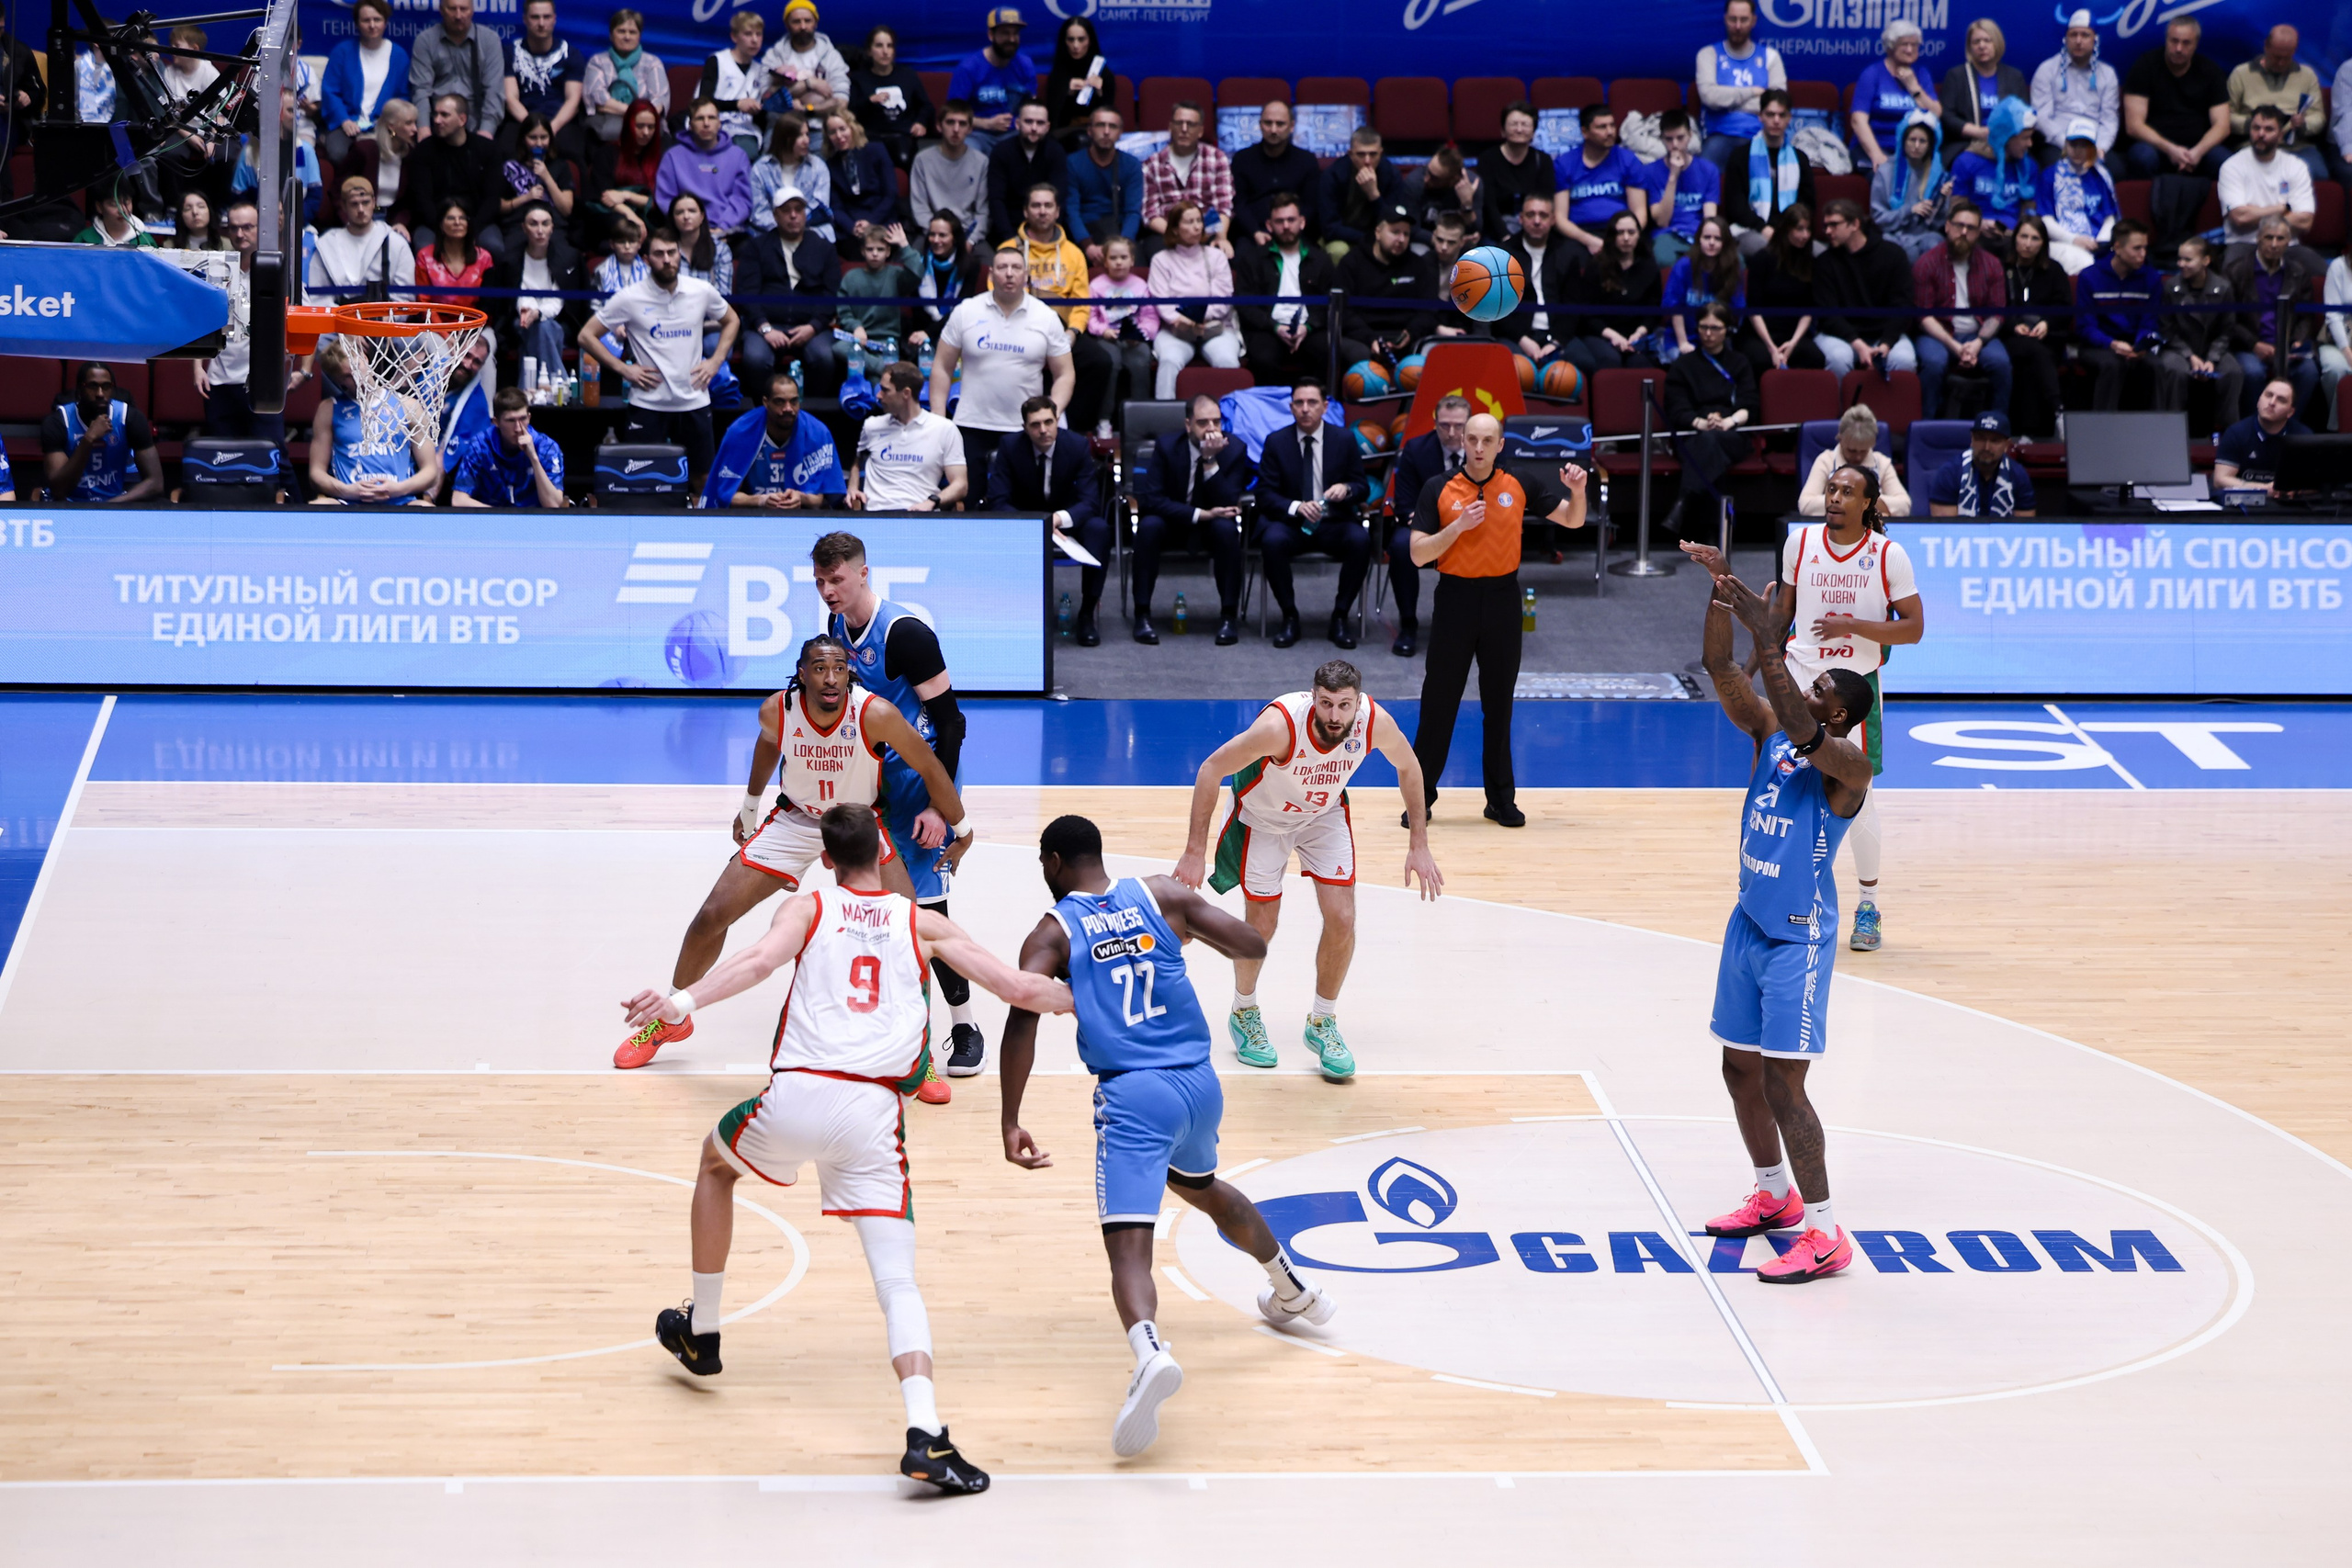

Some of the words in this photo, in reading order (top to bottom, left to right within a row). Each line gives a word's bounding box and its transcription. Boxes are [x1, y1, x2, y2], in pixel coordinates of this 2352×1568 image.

[1919, 530, 2172, 568] ТИТУЛЬНЫЙ
[2184, 537, 2352, 570] СПОНСО
[115, 570, 359, 604] ТИТУЛЬНЫЙ
[369, 577, 559, 607] СПОНСОР
[1811, 573, 1870, 589] LOKOMOTIV
[1821, 591, 1857, 604] KUBAN
[1961, 570, 2134, 615] ЕДИНОЙ
[2144, 579, 2256, 610] ЛИГИ
[2268, 579, 2343, 610] ВТБ
[152, 606, 322, 647] ЕДИНОЙ
[331, 615, 439, 644] ЛИГИ
[450, 616, 521, 645] ВТБ
[794, 743, 854, 758] LOKOMOTIV
[807, 759, 843, 773] KUBAN
[1293, 760, 1354, 776] LOKOMOTIV
[819, 779, 834, 801] 11
[1302, 773, 1340, 785] KUBAN
[1305, 791, 1329, 807] 13
[1749, 808, 1793, 838] ENIT
[847, 954, 882, 1014] 9
[1110, 960, 1168, 1028] 22
